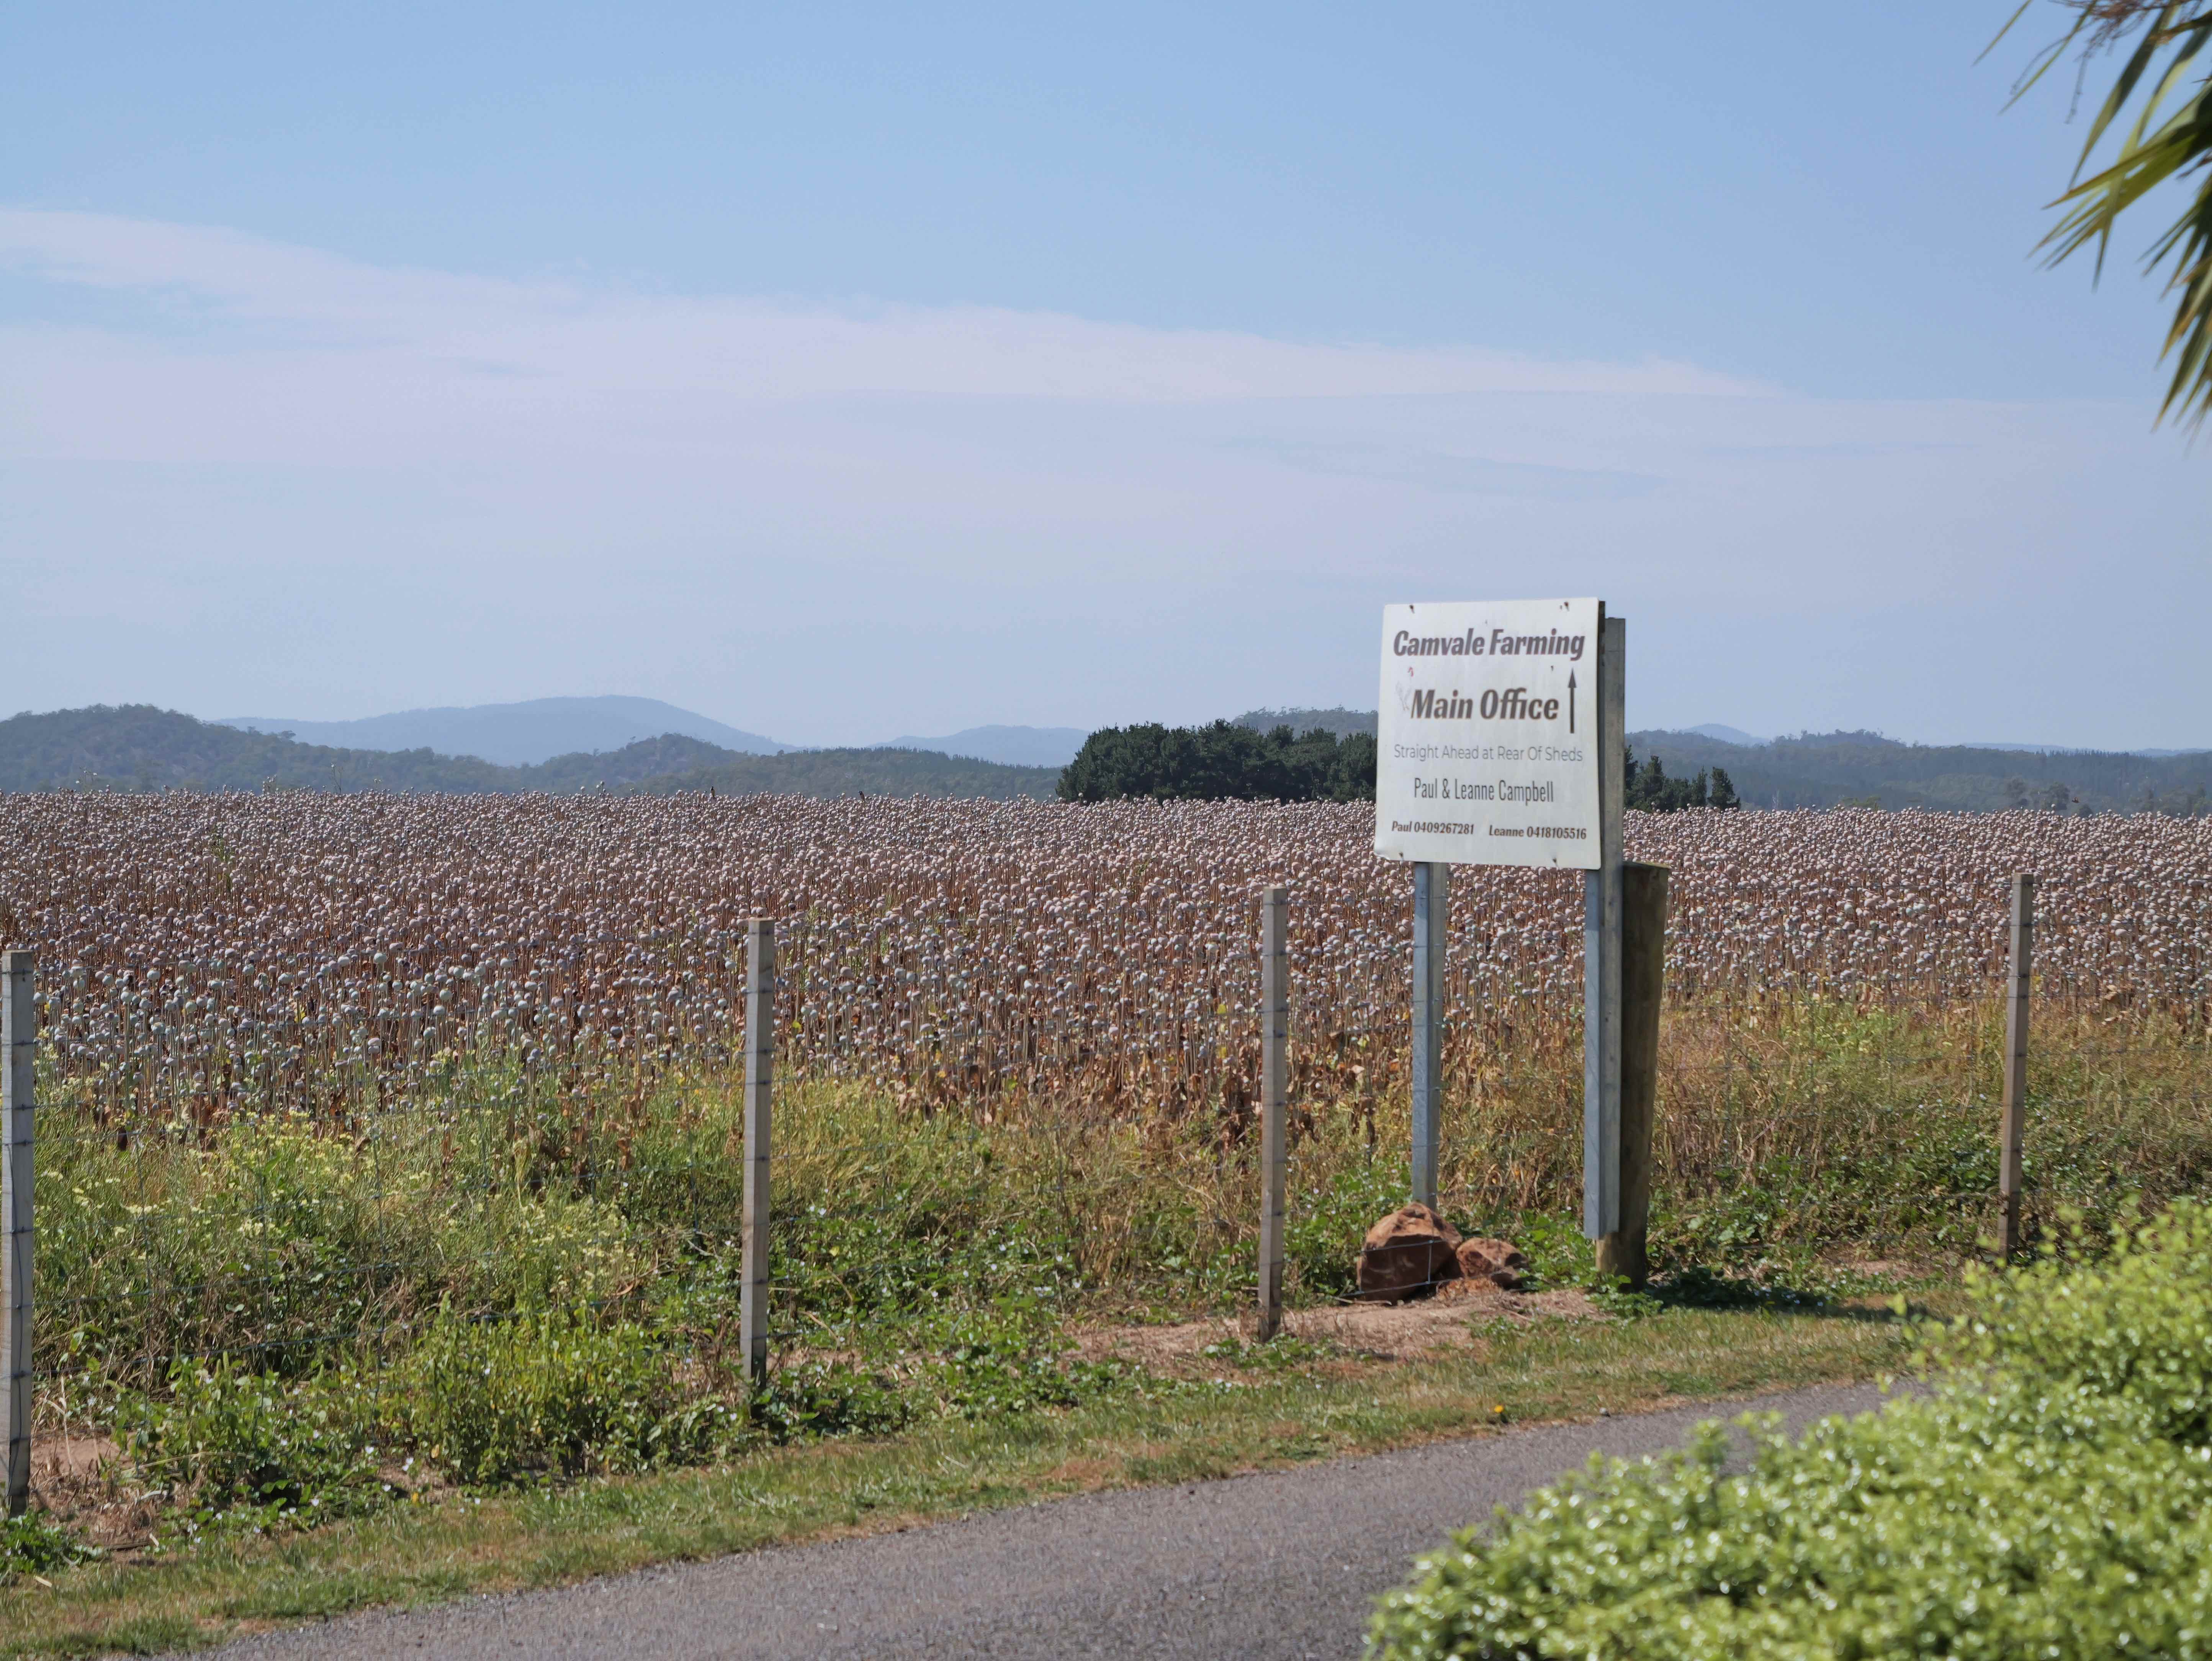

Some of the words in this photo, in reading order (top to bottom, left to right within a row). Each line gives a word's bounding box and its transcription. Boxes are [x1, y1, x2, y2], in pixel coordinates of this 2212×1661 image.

[1394, 628, 1485, 656] Camvale
[1489, 628, 1585, 661] Farming
[1411, 689, 1473, 719] Main
[1480, 687, 1559, 721] Office
[1394, 744, 1439, 762] Straight
[1441, 744, 1479, 760] Ahead
[1482, 747, 1494, 760] at
[1497, 745, 1525, 760] Rear
[1527, 745, 1543, 760] Of
[1545, 746, 1583, 762] Sheds
[1414, 777, 1437, 799] Paul
[1442, 778, 1450, 799] &
[1455, 778, 1494, 801] Leanne
[1499, 780, 1554, 806] Campbell
[1392, 821, 1412, 832] Paul
[1414, 821, 1474, 835] 0409267281
[1489, 824, 1524, 837] Leanne
[1526, 826, 1586, 839] 0418105516
